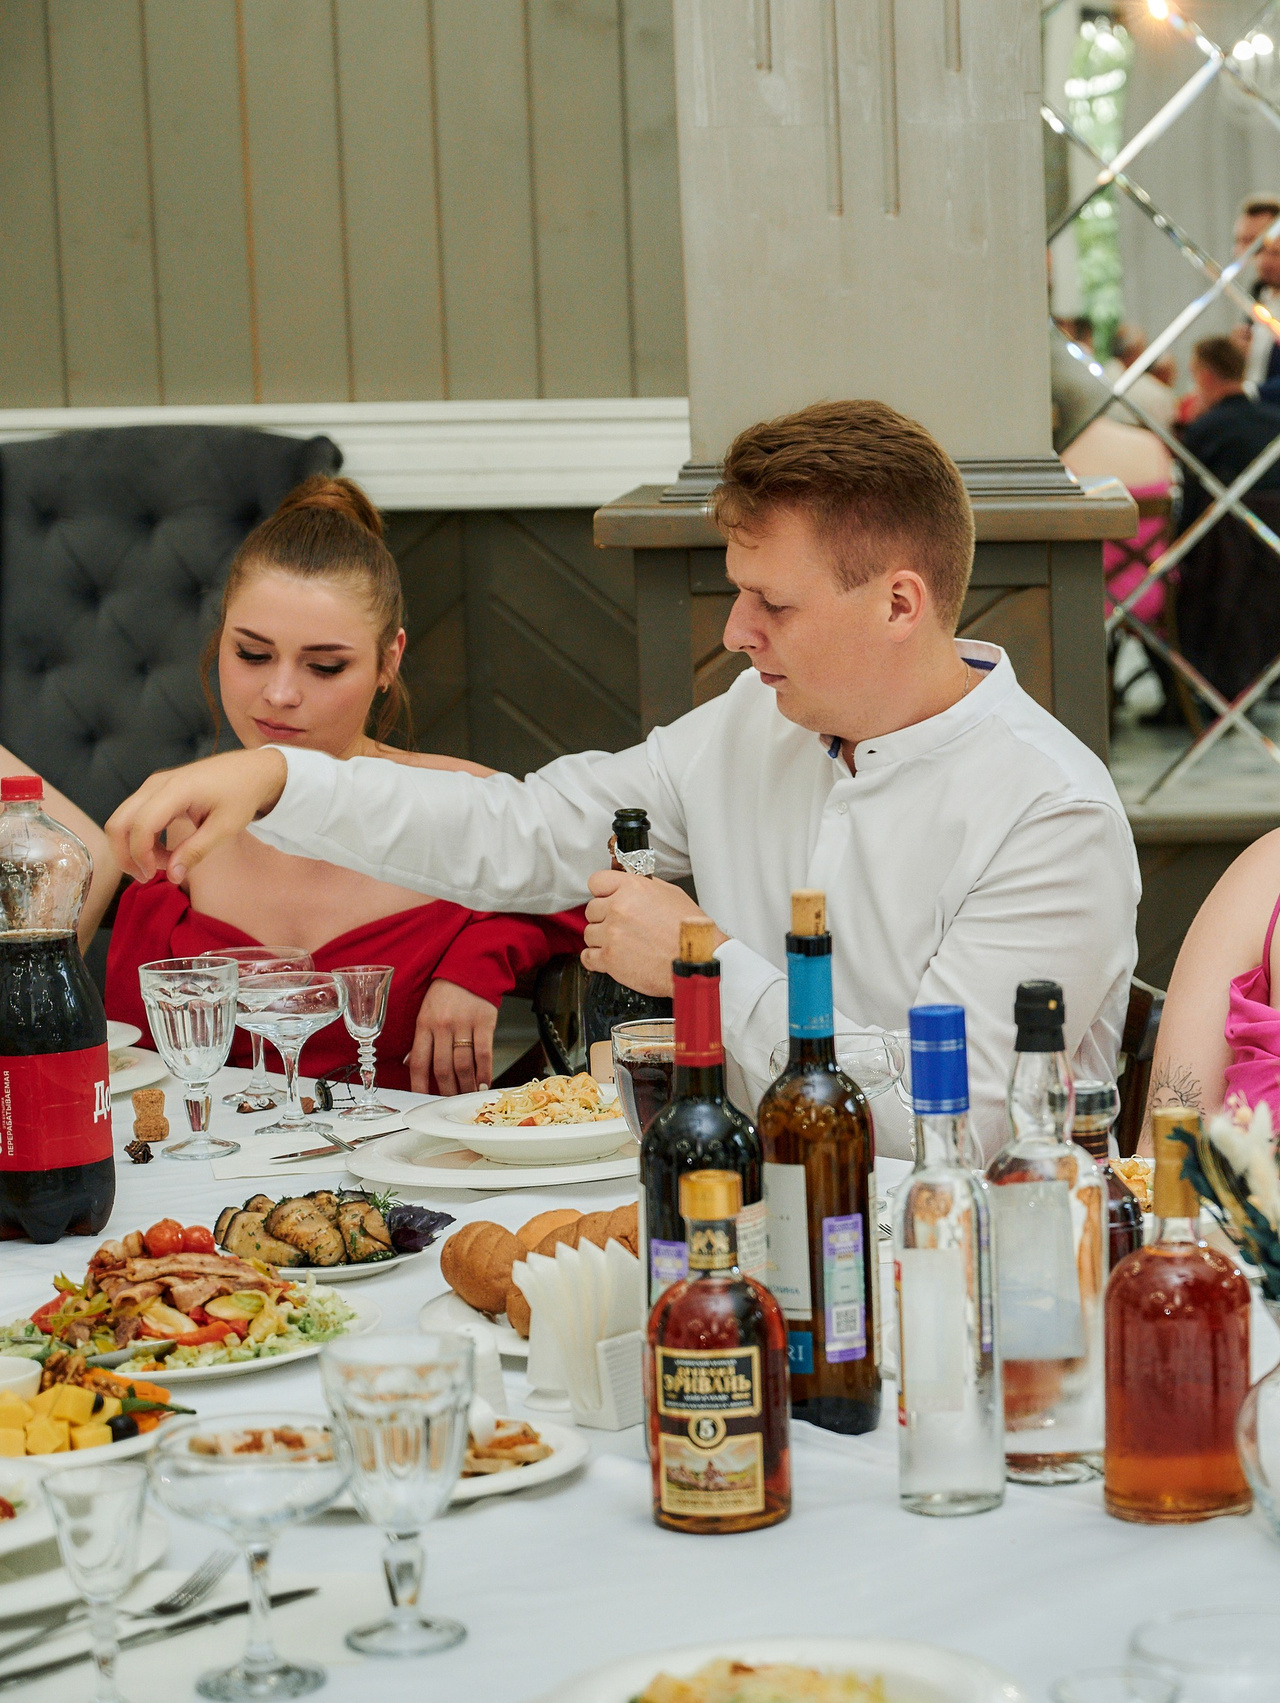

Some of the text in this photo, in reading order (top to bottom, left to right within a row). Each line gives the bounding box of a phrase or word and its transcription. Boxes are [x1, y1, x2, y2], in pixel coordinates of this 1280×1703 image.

[3, 1070, 14, 1156] ПЕРЕРАБАТЫВАЕМАЯ
[663, 1373, 752, 1394] ЭРИВАНЬ
[698, 1417, 715, 1441] 5
